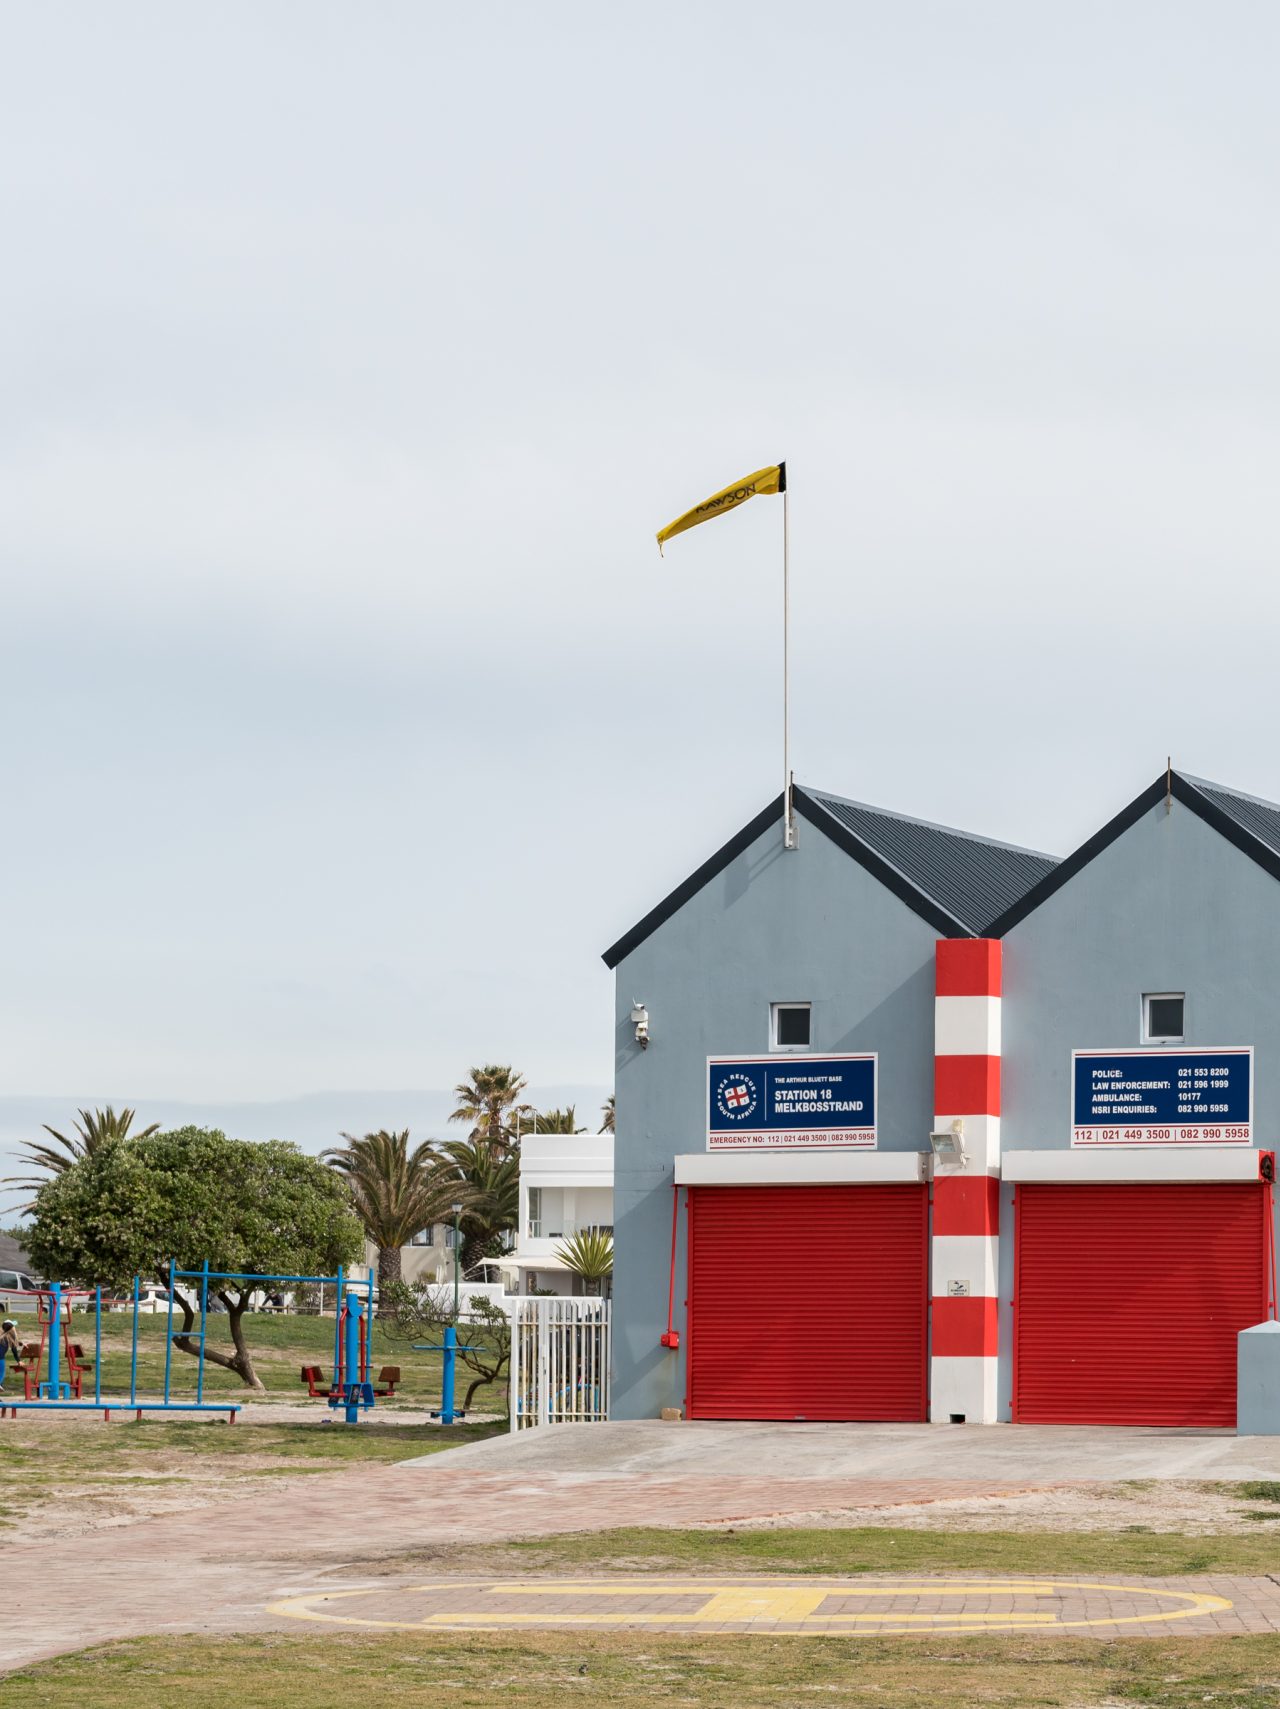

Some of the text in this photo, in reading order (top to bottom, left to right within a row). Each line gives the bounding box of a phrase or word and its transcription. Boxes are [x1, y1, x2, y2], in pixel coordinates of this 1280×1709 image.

[718, 1073, 756, 1093] SEA RESCUE
[1111, 1081, 1170, 1089] ENFORCEMENT:
[775, 1089, 832, 1100] STATION 18
[1092, 1094, 1142, 1102] AMBULANCE:
[717, 1101, 757, 1120] SOUTH AFRICA
[775, 1101, 863, 1113] MELKBOSSTRAND
[1112, 1106, 1157, 1114] ENQUIRIES:
[1210, 1104, 1229, 1112] 5958
[1075, 1129, 1249, 1140] 112 021 449 3500 082 990 5958
